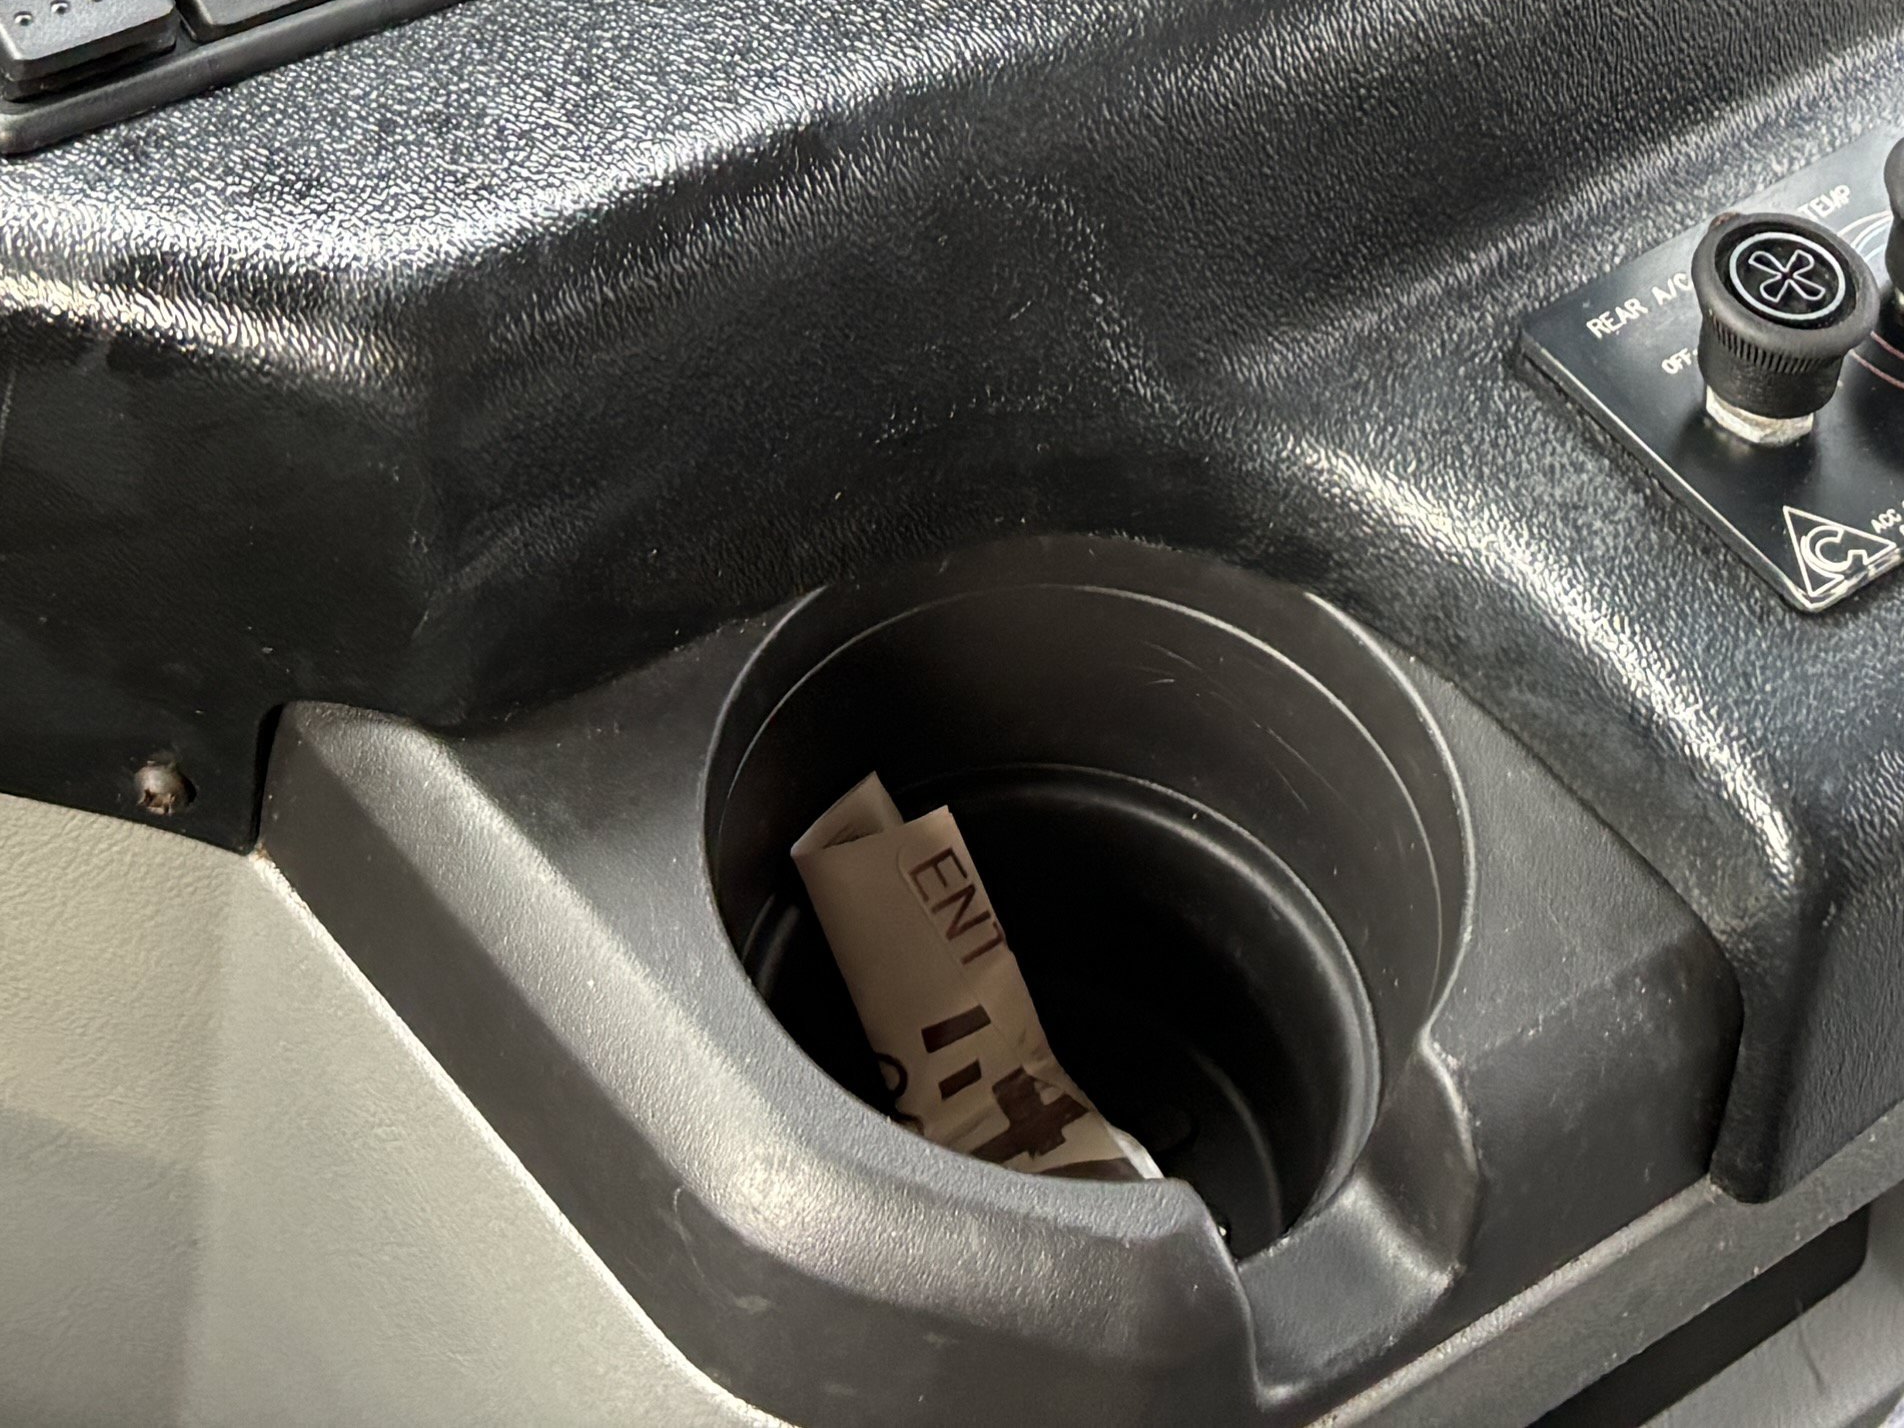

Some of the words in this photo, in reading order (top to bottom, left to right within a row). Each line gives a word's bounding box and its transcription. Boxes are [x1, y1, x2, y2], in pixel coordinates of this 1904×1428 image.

[1798, 183, 1852, 222] TEMP
[1586, 297, 1649, 340] REAR
[1651, 271, 1695, 306] A/C
[1661, 348, 1692, 375] OFF
[1870, 508, 1903, 534] ACC
